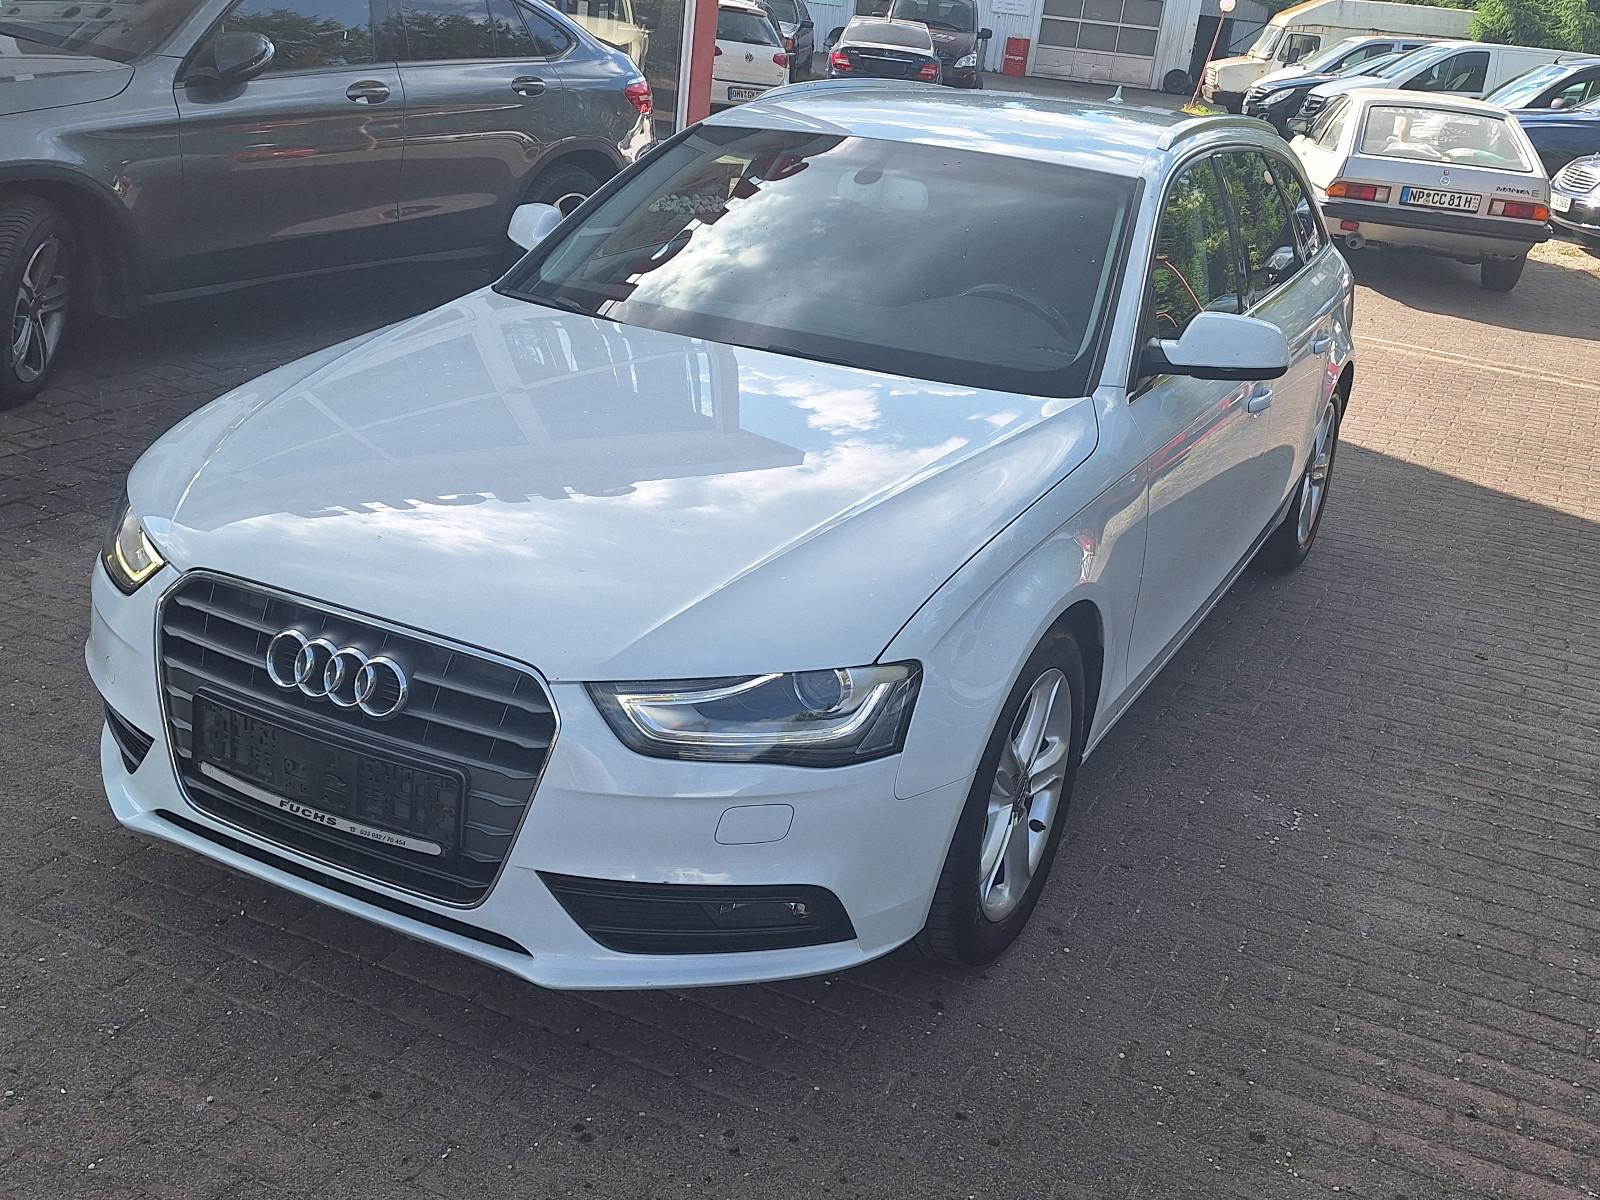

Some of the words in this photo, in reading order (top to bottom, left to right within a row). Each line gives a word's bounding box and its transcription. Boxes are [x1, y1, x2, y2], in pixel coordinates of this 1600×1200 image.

[1409, 189, 1425, 203] NP
[1431, 192, 1447, 206] CC
[279, 799, 337, 826] FUCHS
